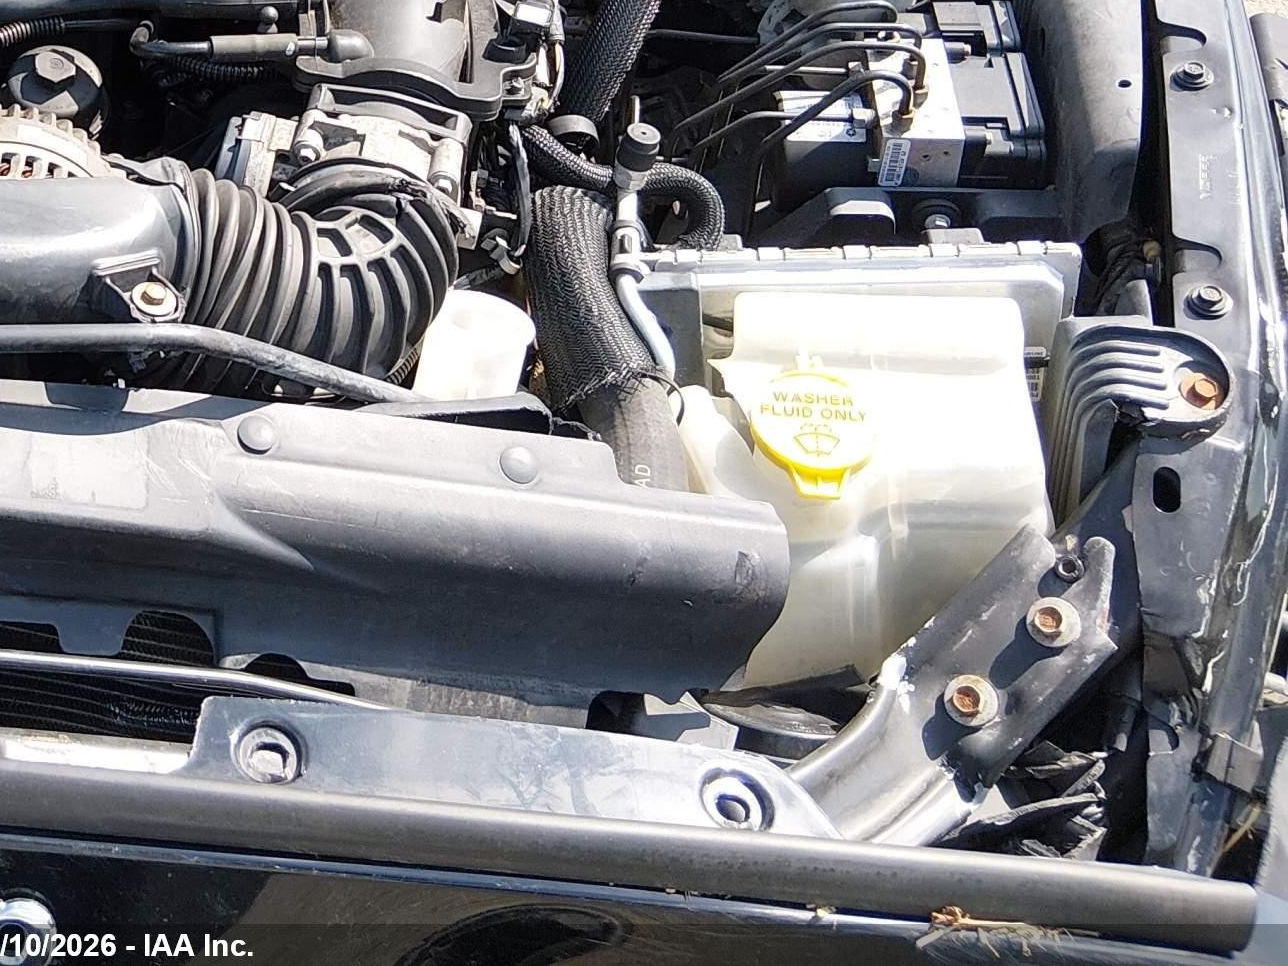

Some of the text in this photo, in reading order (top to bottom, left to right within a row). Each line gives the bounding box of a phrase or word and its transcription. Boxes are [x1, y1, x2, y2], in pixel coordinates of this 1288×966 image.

[772, 390, 854, 407] WASHER
[759, 403, 867, 422] FLUID ONLY
